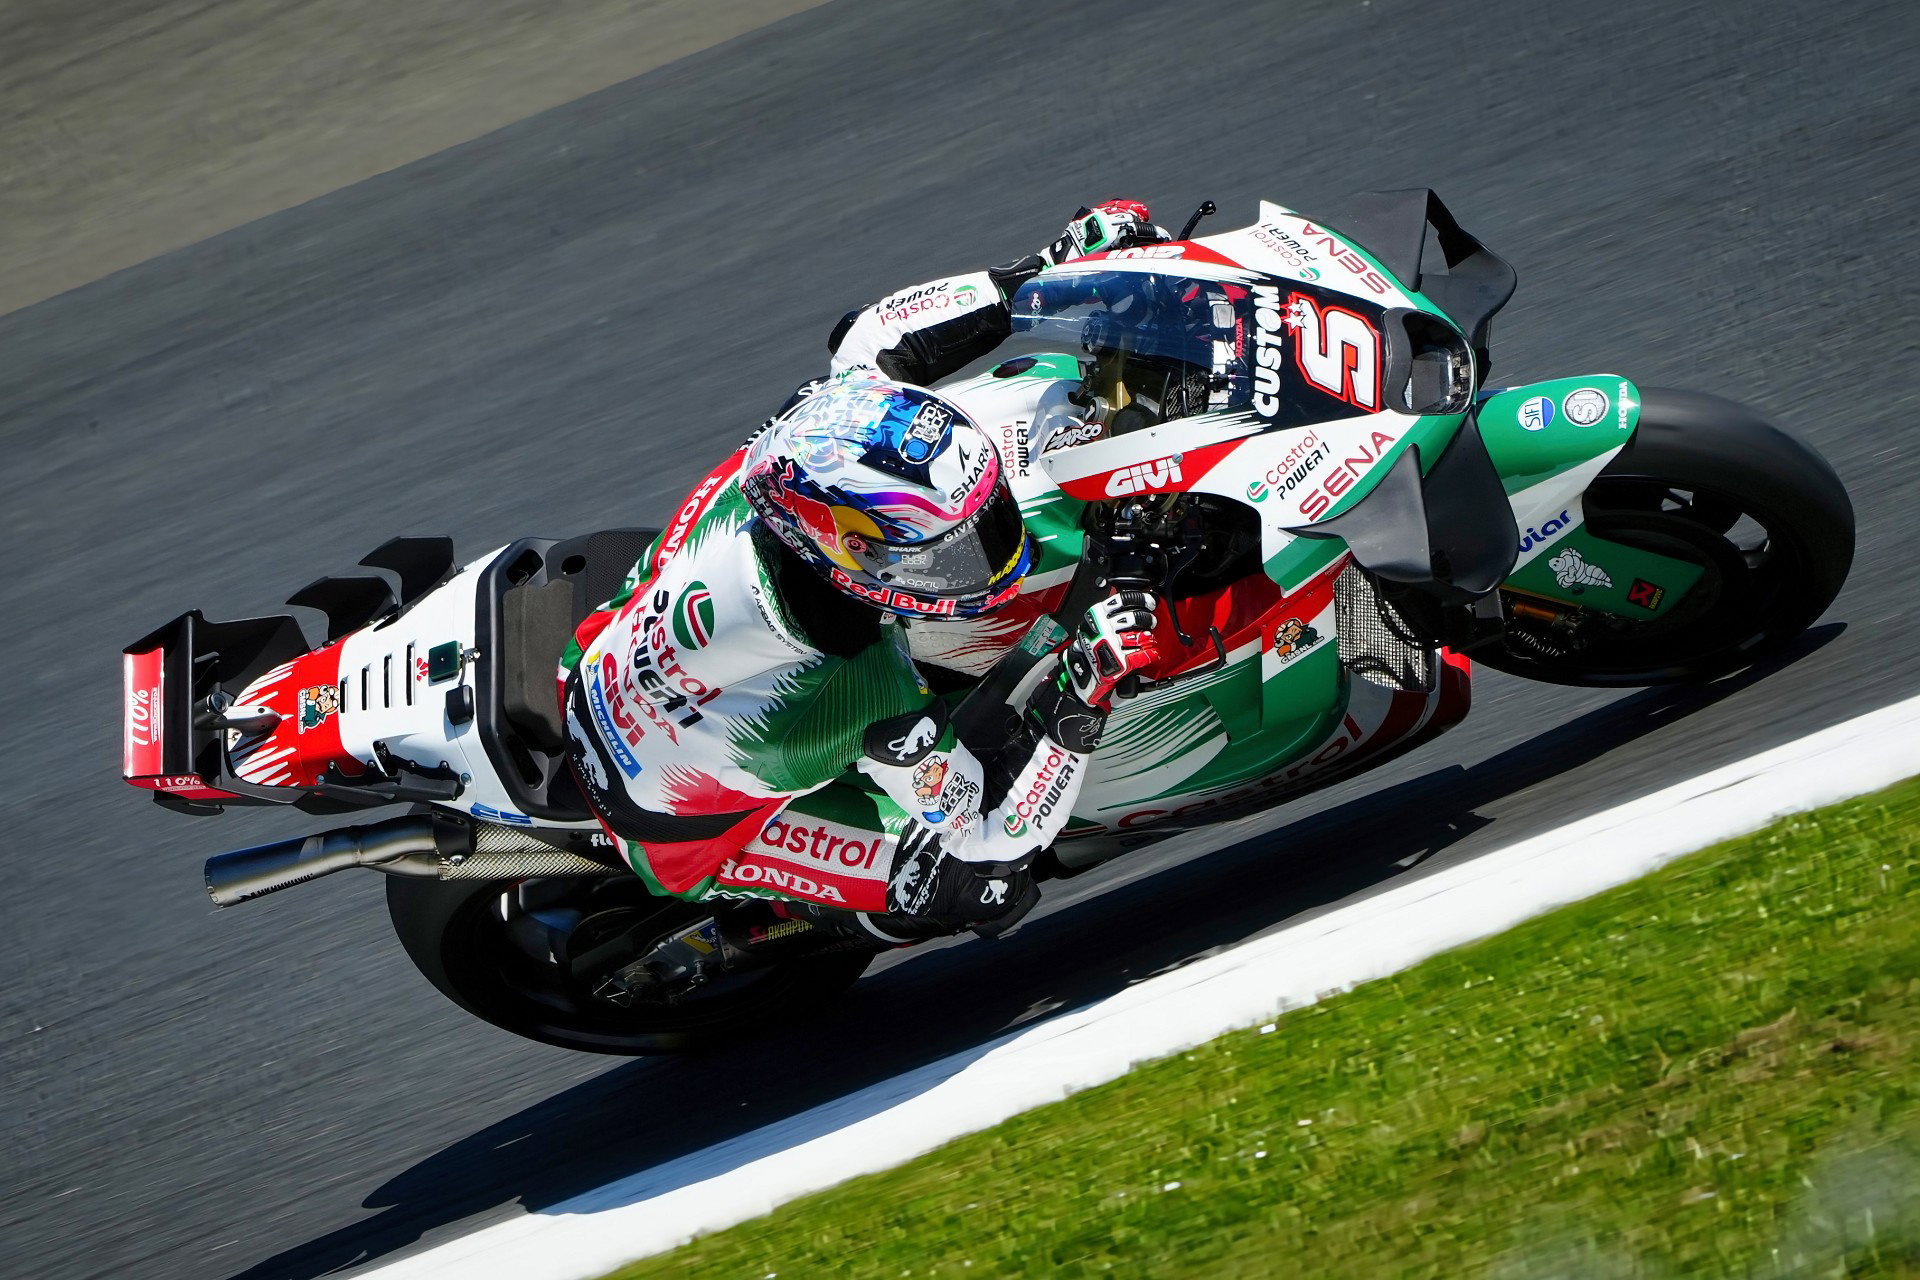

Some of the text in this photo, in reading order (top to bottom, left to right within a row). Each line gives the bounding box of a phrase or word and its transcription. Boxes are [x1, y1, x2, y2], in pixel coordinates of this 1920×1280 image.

[1248, 229, 1302, 267] Castrol
[1303, 222, 1392, 295] SENA
[879, 293, 950, 326] Castrol
[1253, 284, 1282, 418] CUSTOM
[1297, 296, 1378, 412] 5
[1524, 401, 1542, 428] SIFI
[1617, 381, 1628, 430] HODA
[950, 442, 990, 505] SHARK
[1104, 457, 1183, 497] GIVI
[1265, 429, 1319, 485] Castrol
[1299, 431, 1396, 522] SENA
[943, 514, 981, 543] GIVES
[755, 597, 777, 632] AIRBAG
[829, 567, 892, 604] Red
[892, 591, 957, 617] Bull
[129, 689, 149, 746] 110%
[602, 652, 646, 748] GIVI
[590, 688, 633, 767] MICHELIN
[153, 776, 201, 788] 110%
[1015, 745, 1065, 819] Castrol
[720, 858, 847, 903] HONDA
